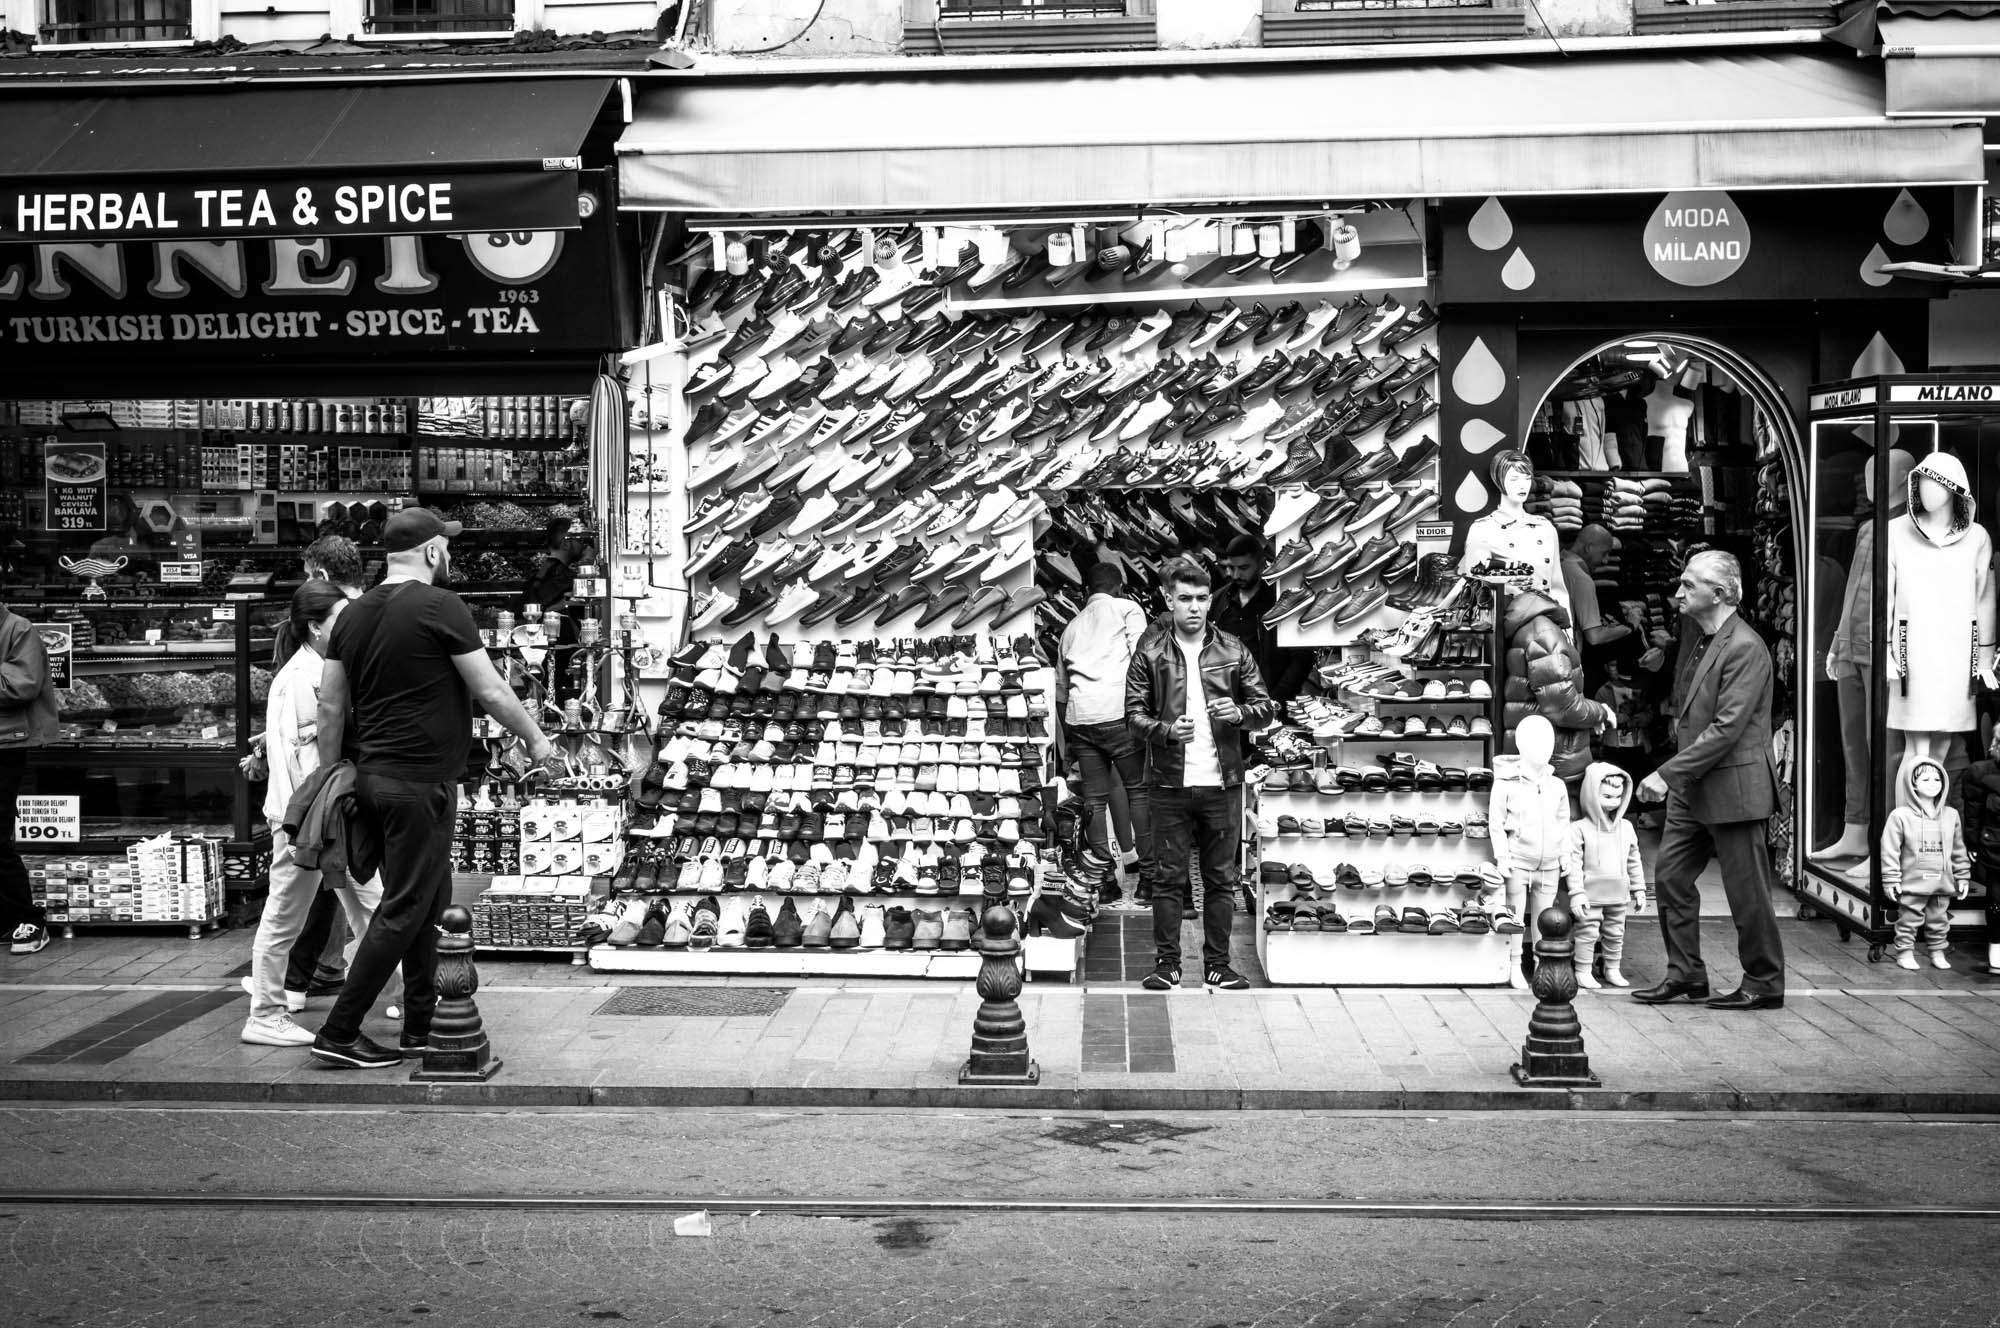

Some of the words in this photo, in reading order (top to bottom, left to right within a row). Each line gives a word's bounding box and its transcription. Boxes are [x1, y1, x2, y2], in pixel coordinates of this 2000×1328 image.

[18, 192, 178, 231] HERBAL
[194, 189, 277, 228] TEA
[292, 186, 319, 226] &
[334, 183, 453, 225] SPICE
[1664, 208, 1729, 228] MODA
[1654, 235, 1741, 262] MİLANO
[498, 289, 540, 304] 1963
[9, 314, 164, 343] TURKISH
[170, 311, 321, 341] DELIGHT
[346, 309, 446, 336] SPICE
[467, 306, 540, 334] TEA
[1824, 394, 1839, 409] MODA
[54, 507, 98, 516] BAKLAVA
[61, 516, 85, 529] 319
[19, 825, 59, 839] 190
[60, 830, 74, 838] TL
